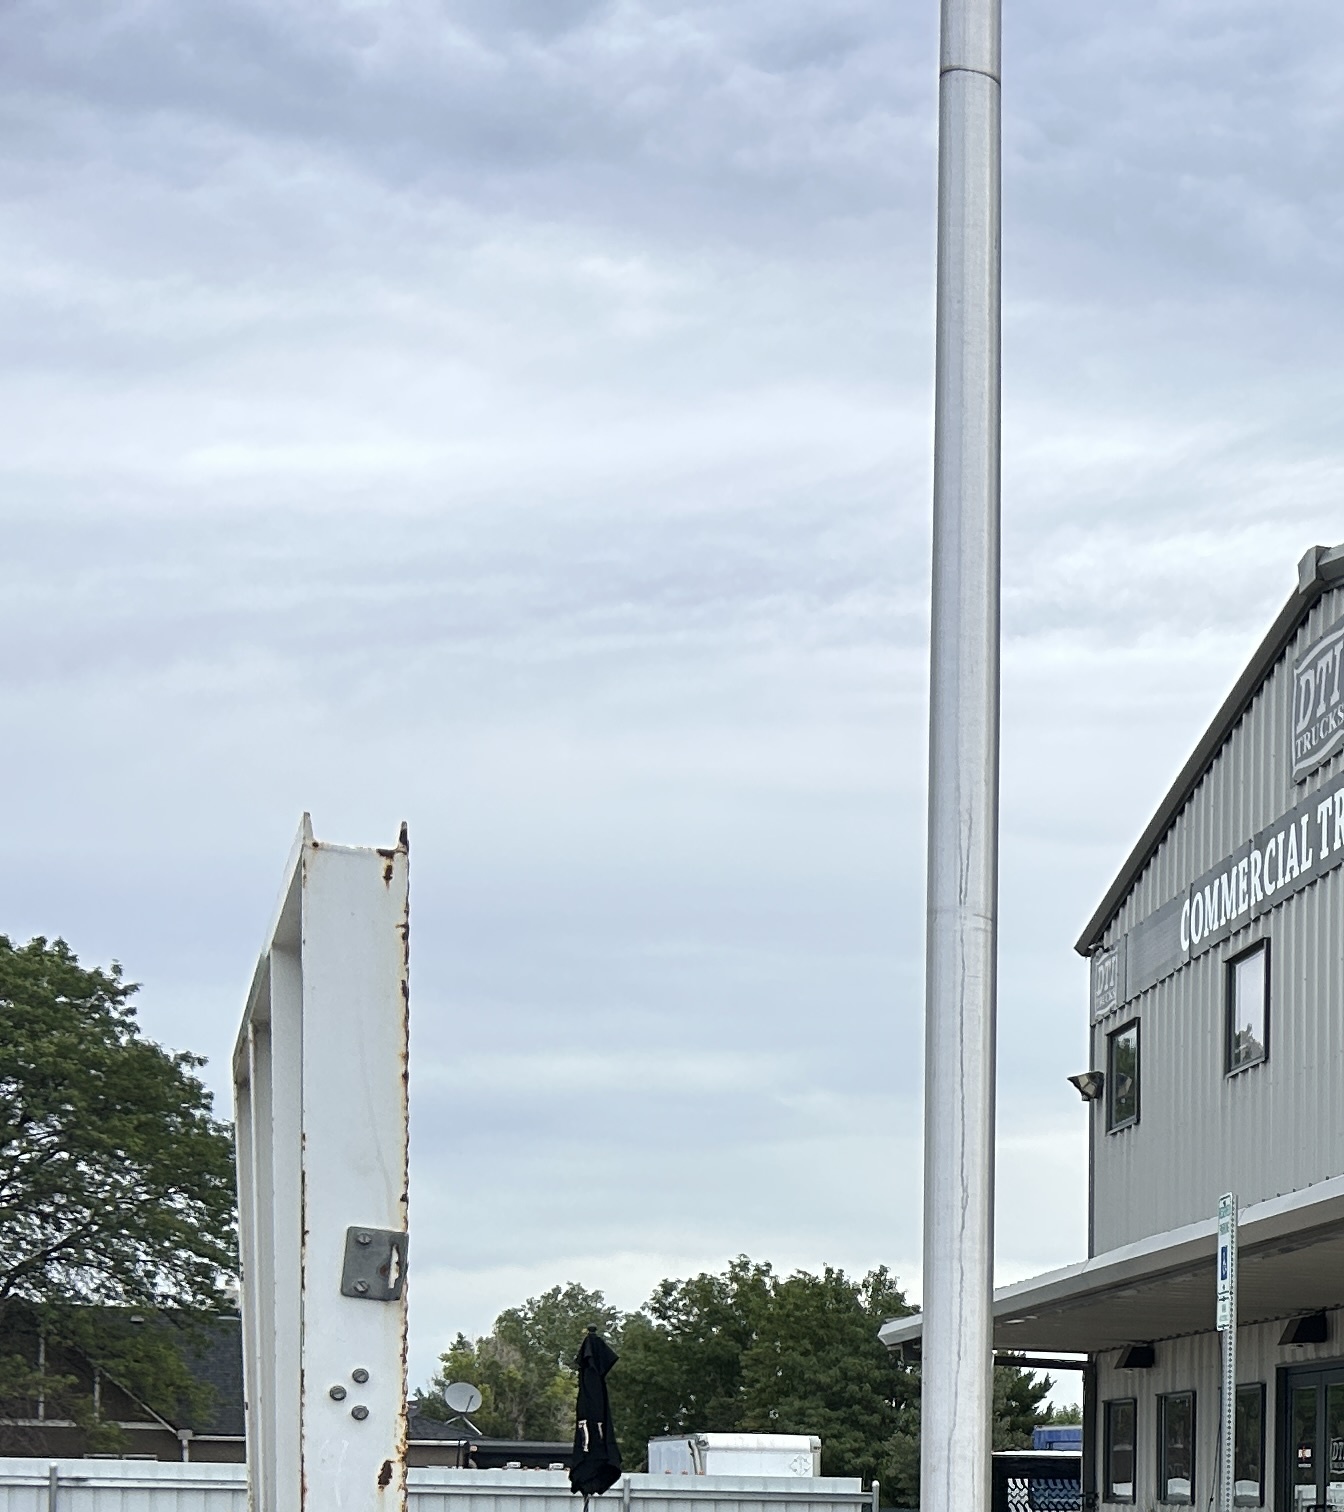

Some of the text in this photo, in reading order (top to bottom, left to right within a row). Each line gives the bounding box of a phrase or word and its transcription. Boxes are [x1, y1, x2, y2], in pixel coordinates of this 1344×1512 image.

[1296, 639, 1344, 735] DTI
[1296, 703, 1344, 759] TRUCKS
[1180, 813, 1313, 951] COMMERCIAL
